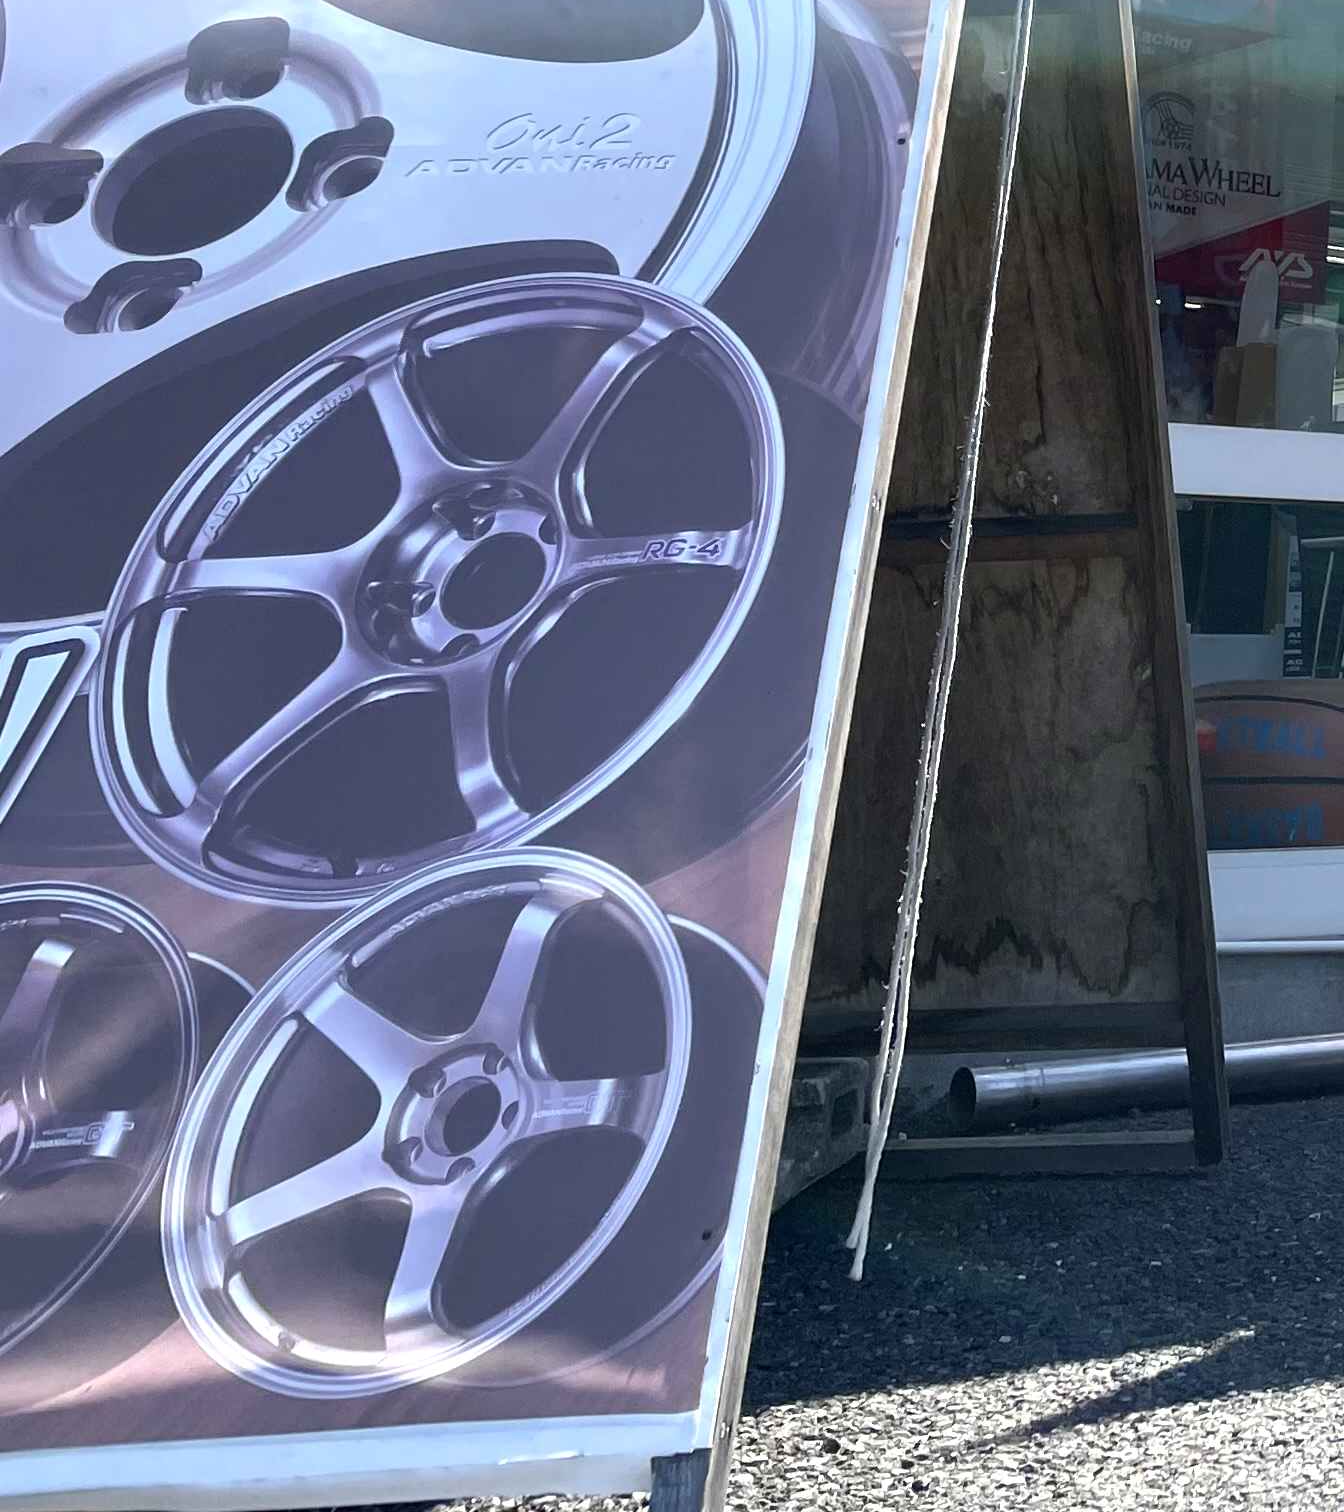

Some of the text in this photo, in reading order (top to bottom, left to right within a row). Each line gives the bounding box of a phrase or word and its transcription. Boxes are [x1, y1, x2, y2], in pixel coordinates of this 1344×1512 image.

[1146, 156, 1282, 199] MA WHEEL
[1175, 188, 1227, 208] DESIGN
[1165, 202, 1198, 217] MADE
